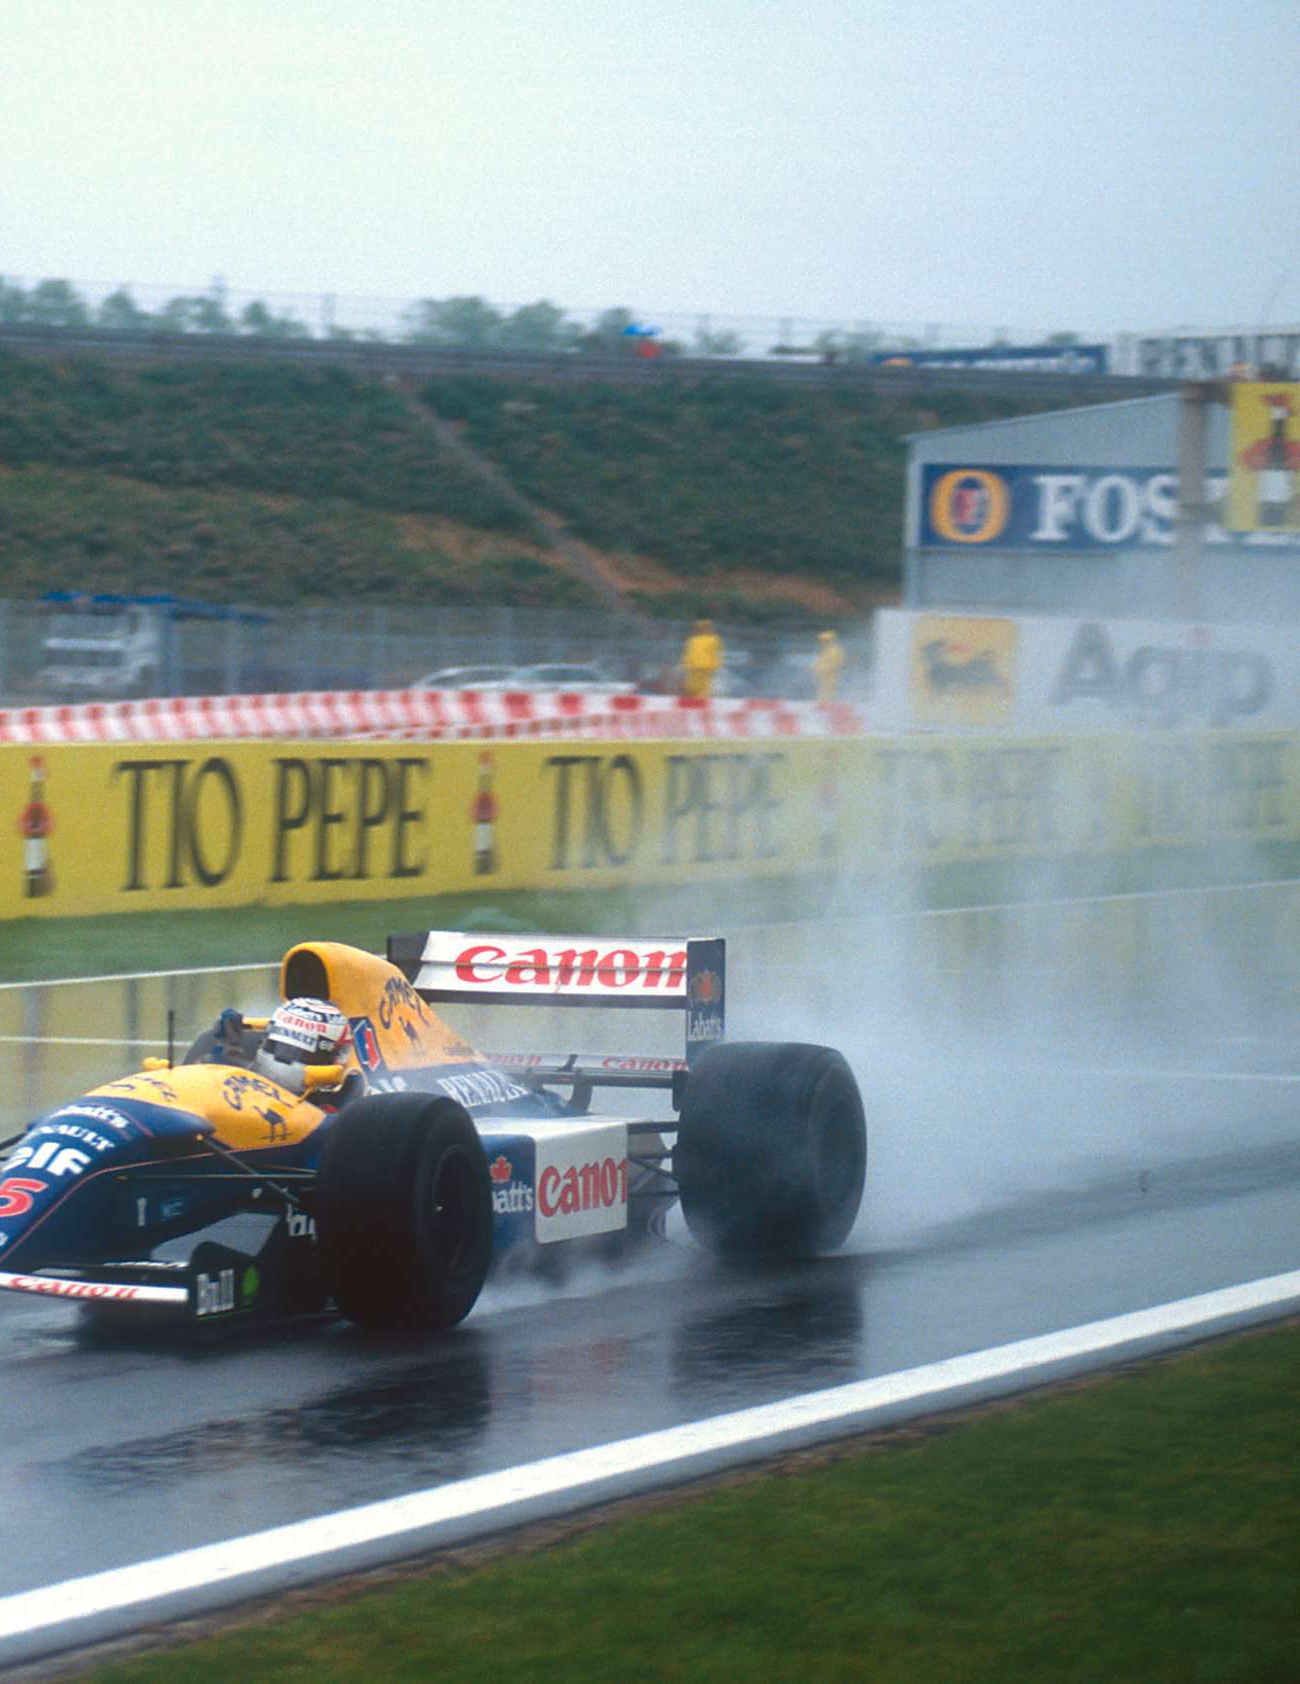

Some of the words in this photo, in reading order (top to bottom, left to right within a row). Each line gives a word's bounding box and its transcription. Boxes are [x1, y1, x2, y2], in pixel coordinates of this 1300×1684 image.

[113, 757, 243, 890] TIO
[267, 757, 429, 884] PEPE
[542, 753, 646, 871] TIO
[453, 945, 688, 989] Canon
[602, 1056, 688, 1072] Canon
[9, 1274, 141, 1298] Canon
